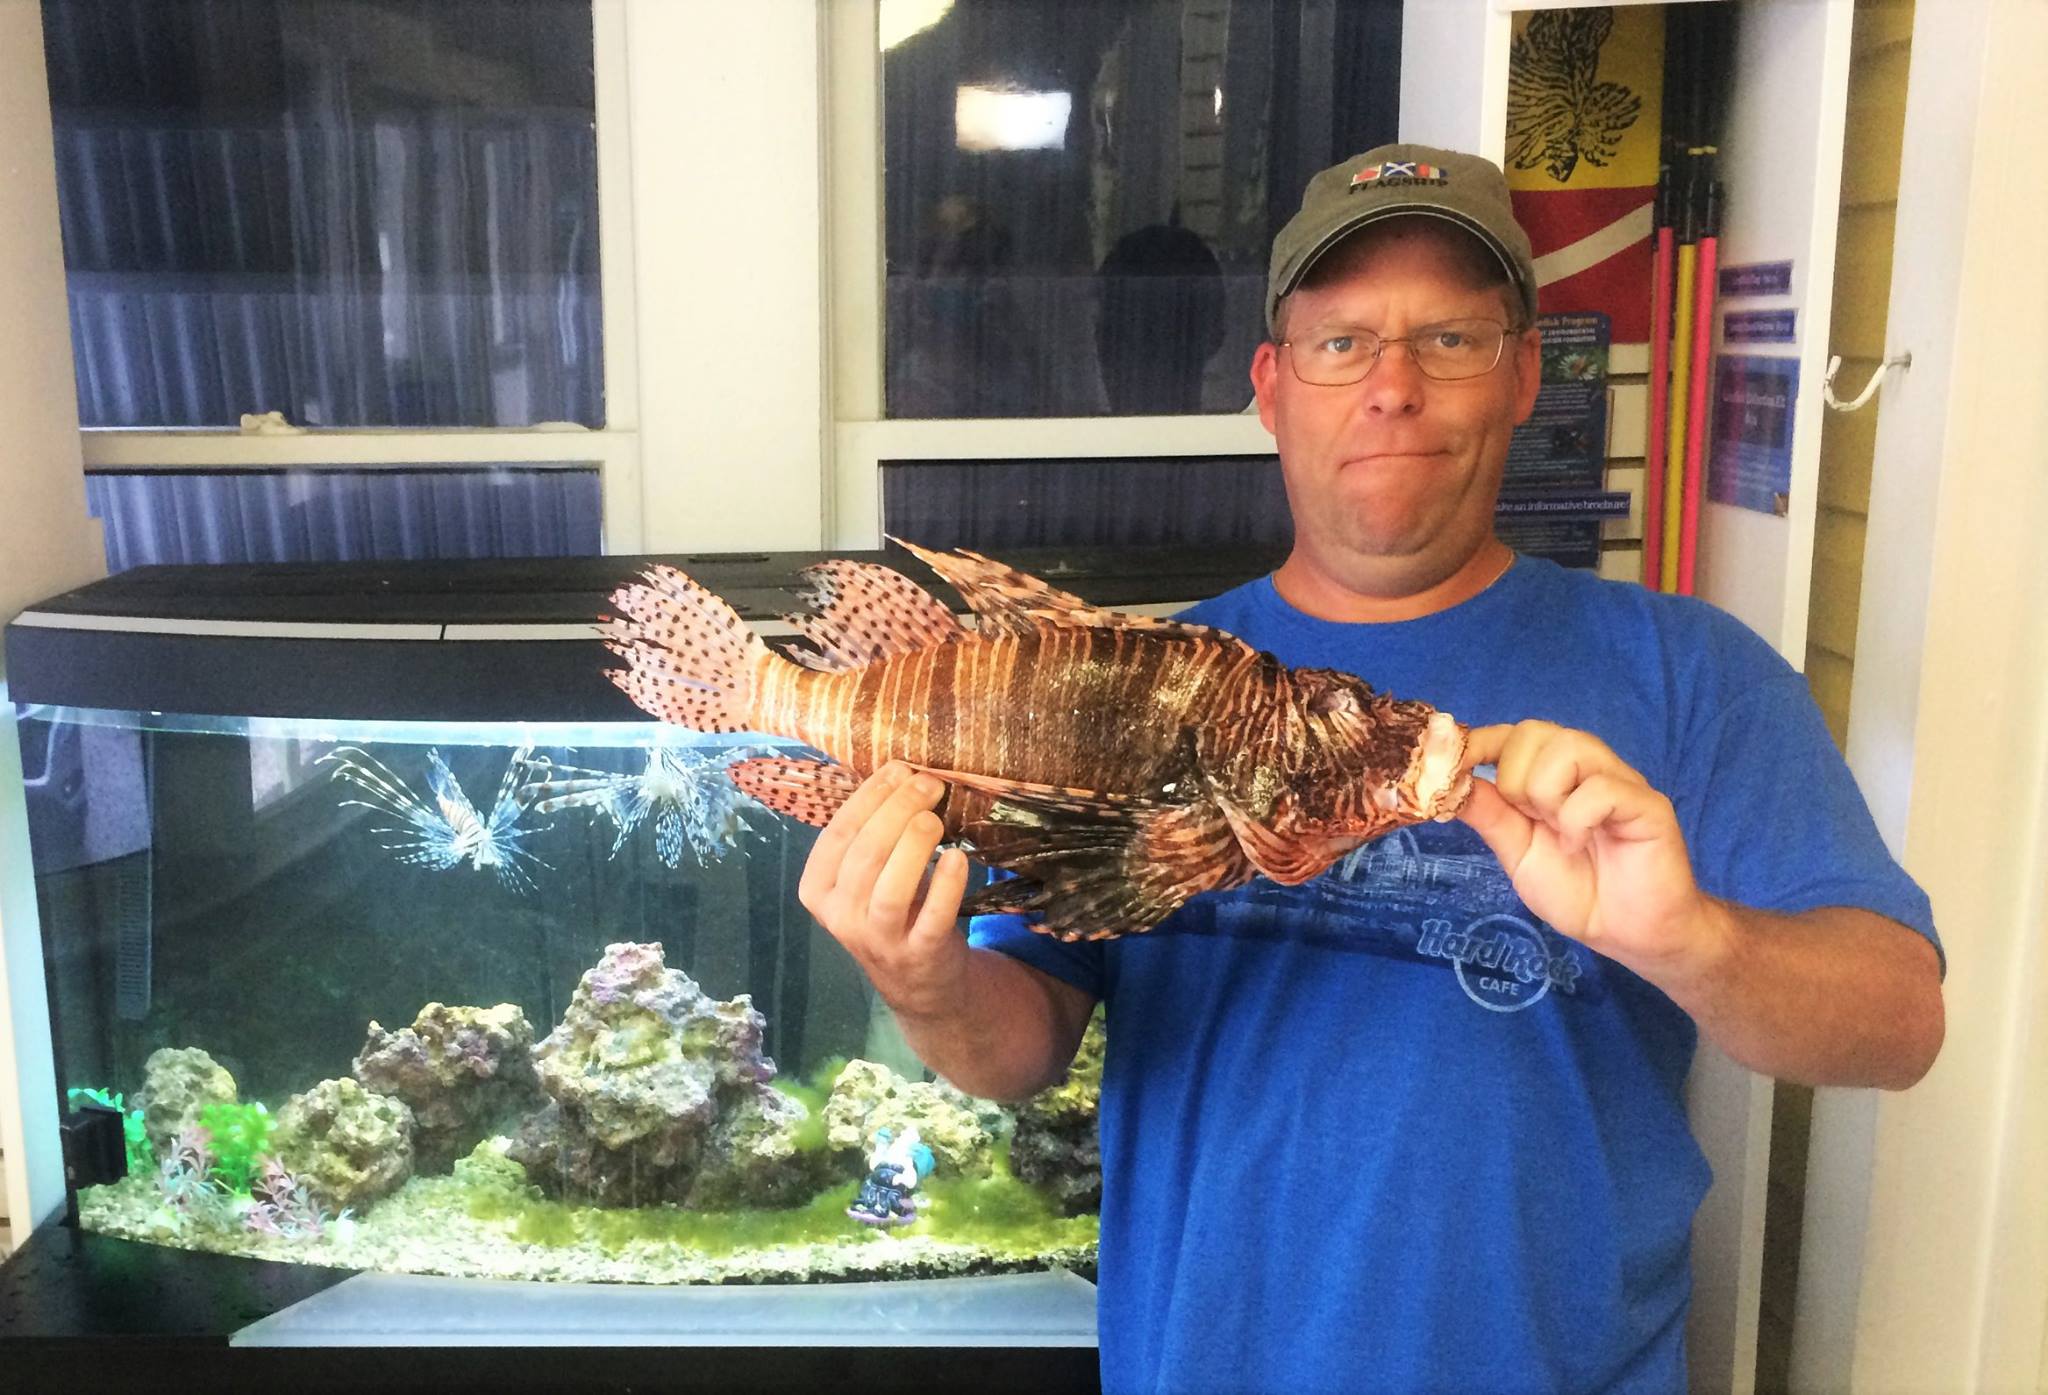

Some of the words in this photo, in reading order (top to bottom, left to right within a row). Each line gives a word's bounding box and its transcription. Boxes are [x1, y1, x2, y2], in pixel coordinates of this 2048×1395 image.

[1349, 177, 1448, 194] FLAGSHIP
[1562, 316, 1598, 327] Program
[1514, 502, 1526, 511] an
[1528, 501, 1584, 511] informative
[1416, 918, 1509, 969] Hard
[1503, 936, 1583, 995] Rock
[1479, 976, 1520, 996] CAFE
